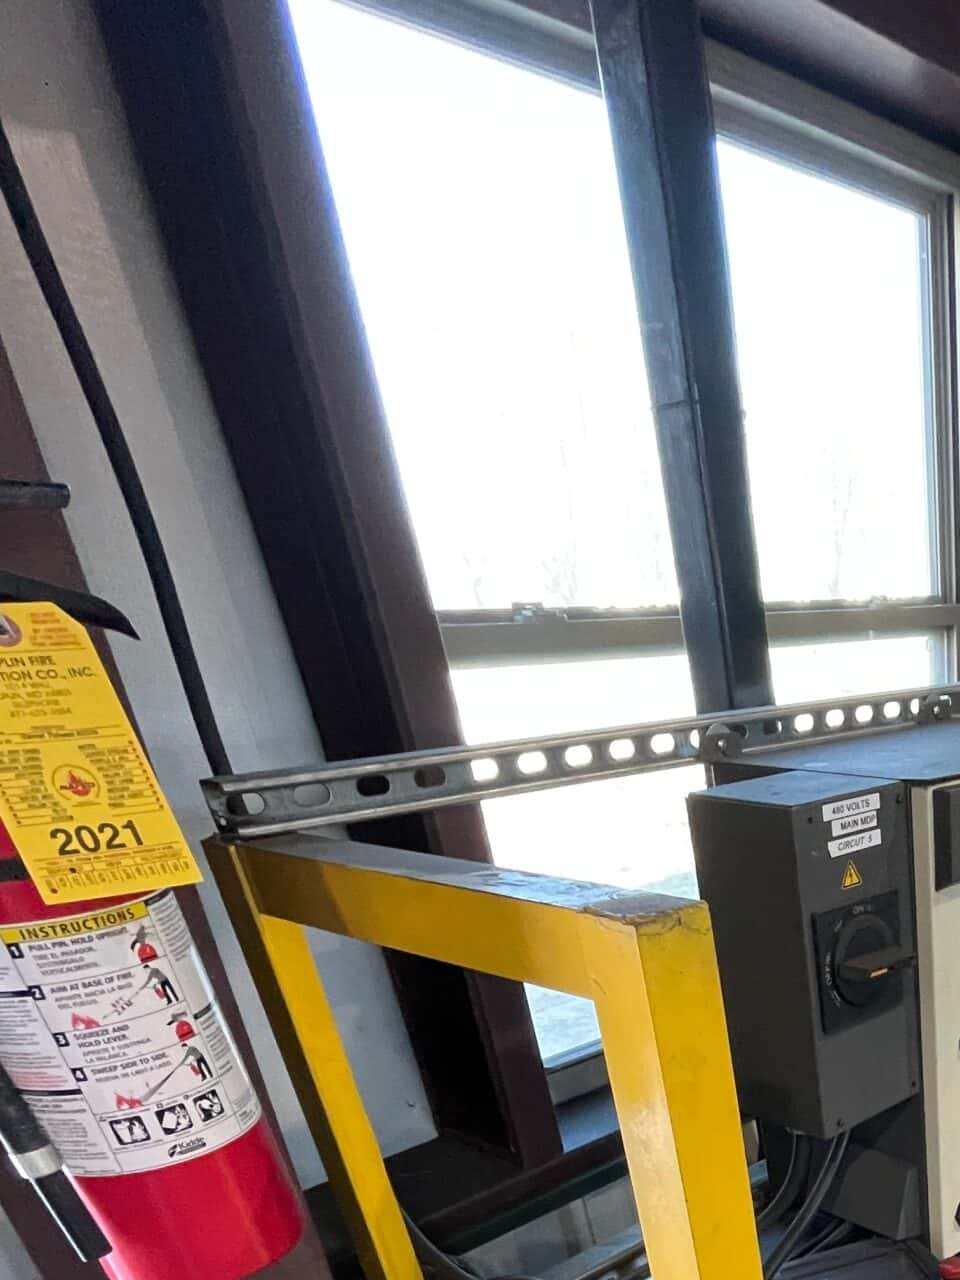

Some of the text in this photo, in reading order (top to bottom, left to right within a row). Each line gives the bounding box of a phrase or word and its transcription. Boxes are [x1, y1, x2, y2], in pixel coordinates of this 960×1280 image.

[28, 656, 56, 666] FIRE
[846, 798, 870, 812] VOLTS
[840, 814, 876, 830] MAIN MDP
[50, 820, 144, 857] 2021
[838, 836, 864, 852] CIRCUT
[19, 908, 135, 940] INSTRUCTIONS
[28, 942, 50, 952] PULL
[82, 978, 104, 989] BASE
[104, 976, 114, 984] OF
[73, 1024, 130, 1040] SQUEEZE AND
[78, 1040, 101, 1048] HOLD
[90, 1065, 118, 1076] SWEEP
[120, 1060, 138, 1070] SIDE
[140, 1057, 150, 1065] TO
